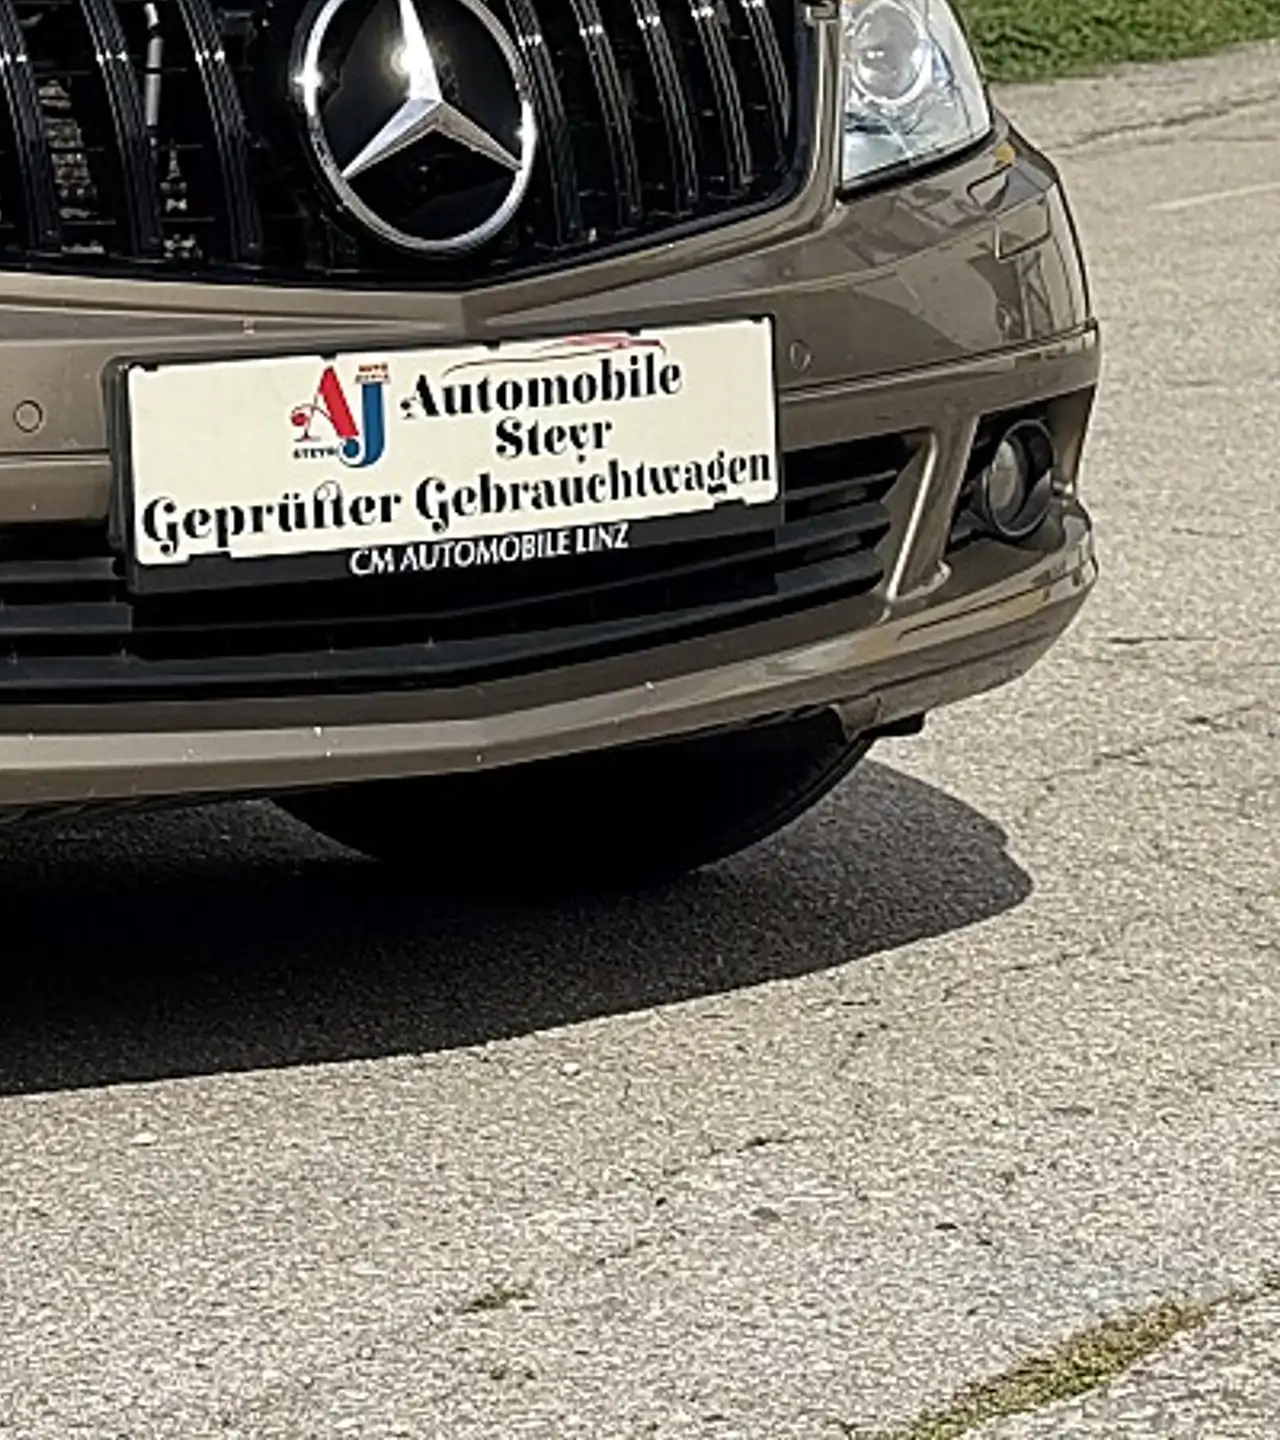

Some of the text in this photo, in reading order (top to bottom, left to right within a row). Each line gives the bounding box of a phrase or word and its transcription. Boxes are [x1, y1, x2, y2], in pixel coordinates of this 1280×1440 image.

[400, 351, 682, 419] Automobile
[495, 417, 614, 462] Steyr
[415, 450, 773, 533] Gebrauchtwagen
[349, 523, 629, 576] CM AUTOMOBILE LINZ
